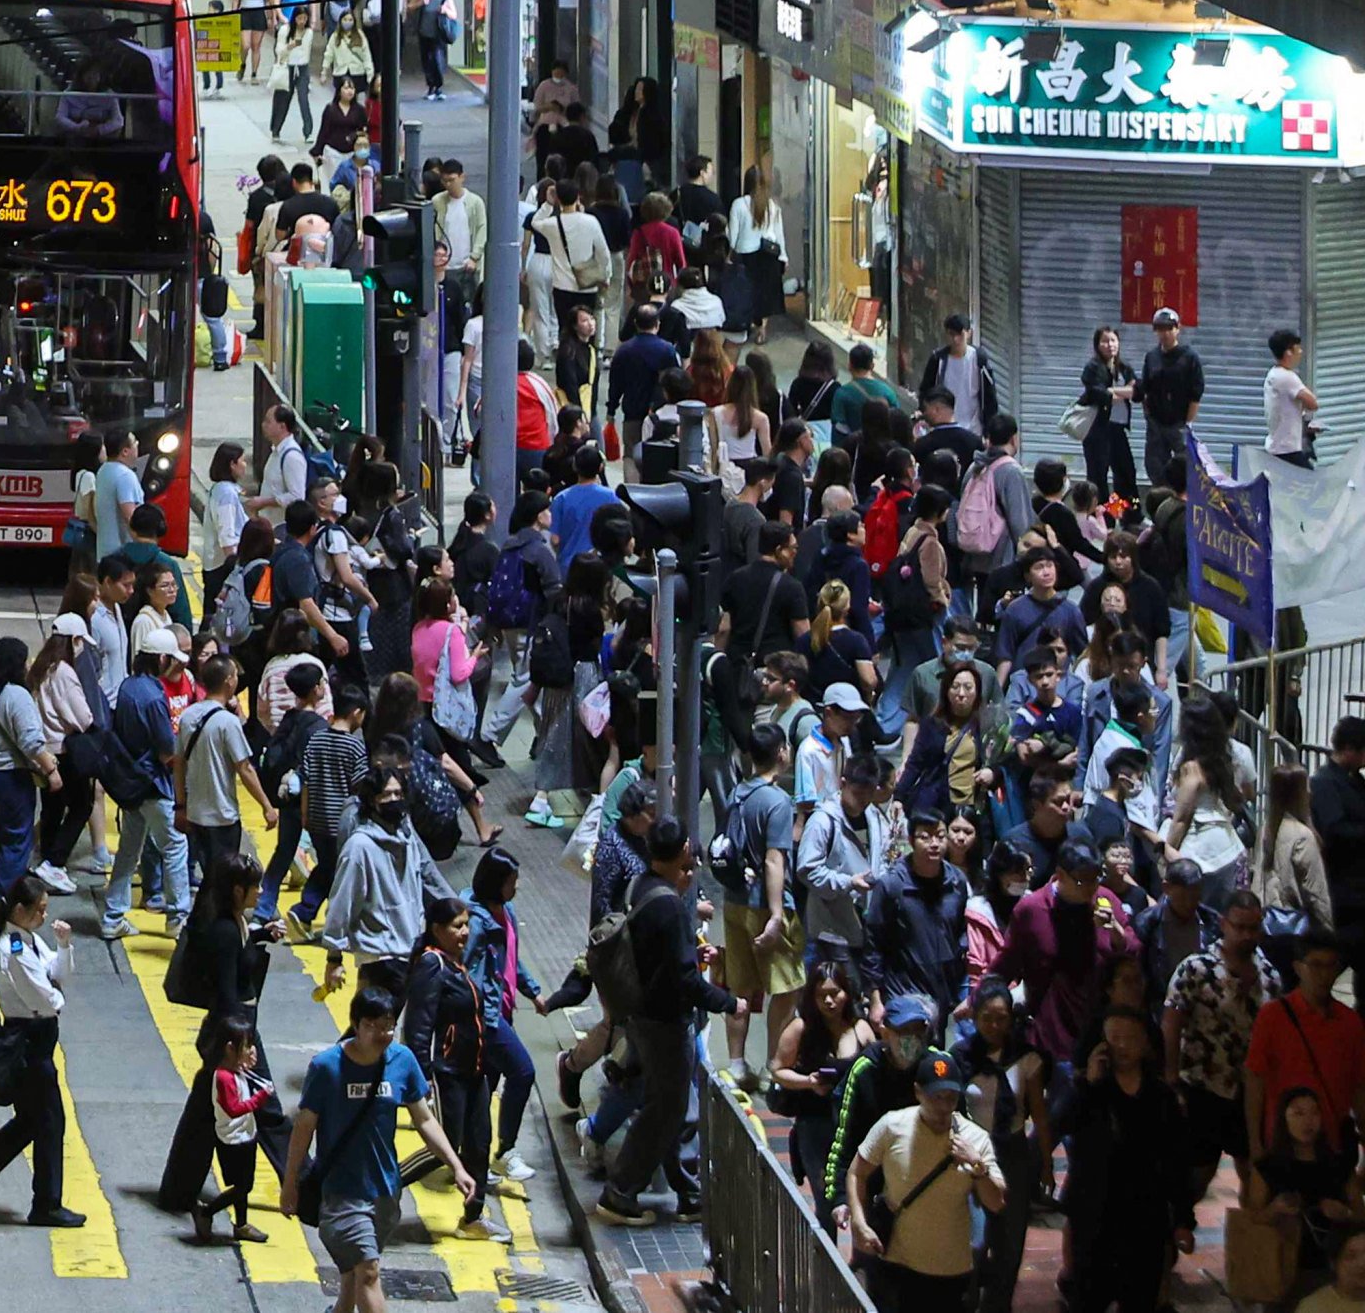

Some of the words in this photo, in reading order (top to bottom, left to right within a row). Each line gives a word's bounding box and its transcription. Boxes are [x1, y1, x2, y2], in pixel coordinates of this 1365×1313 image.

[972, 105, 1012, 135] SUN
[1019, 106, 1101, 139] CHEUNG
[1106, 109, 1248, 144] DISPENSARY
[46, 179, 117, 224] 673
[15, 528, 43, 541] 890
